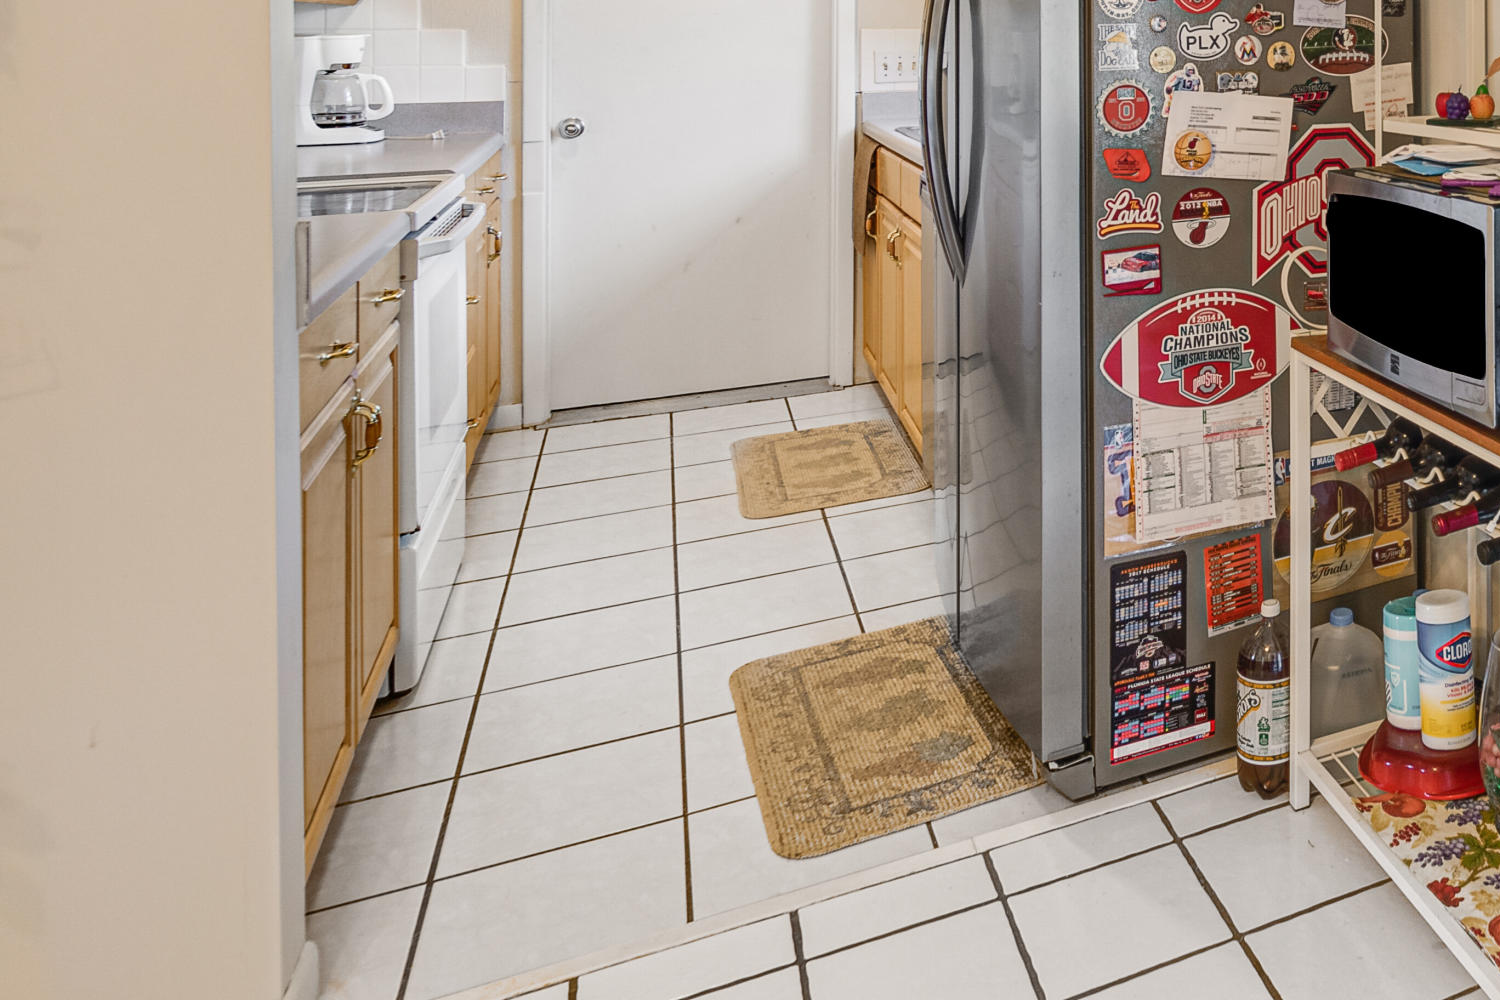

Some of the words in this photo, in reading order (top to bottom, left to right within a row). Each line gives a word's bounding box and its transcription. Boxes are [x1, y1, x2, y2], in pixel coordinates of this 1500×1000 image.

[1187, 35, 1221, 50] PLX
[1182, 79, 1193, 90] 13
[1100, 190, 1157, 228] Land
[1180, 201, 1202, 210] 2012
[1261, 175, 1321, 261] OHIO
[1197, 314, 1216, 324] 2014
[1180, 320, 1233, 337] NATIONAL
[1163, 327, 1249, 353] CHAMPIONS
[1173, 354, 1189, 370] OHIO
[1188, 351, 1208, 364] STATE
[1208, 346, 1240, 361] BUCKEYES
[1143, 564, 1171, 574] SCHEDULE
[1442, 640, 1472, 661] CLORO
[1127, 680, 1150, 689] FLORIDA
[1150, 675, 1165, 684] STATE
[1165, 670, 1186, 680] LEAGUE
[1186, 664, 1211, 675] SCHEDULE
[1444, 678, 1469, 688] Disinfecting
